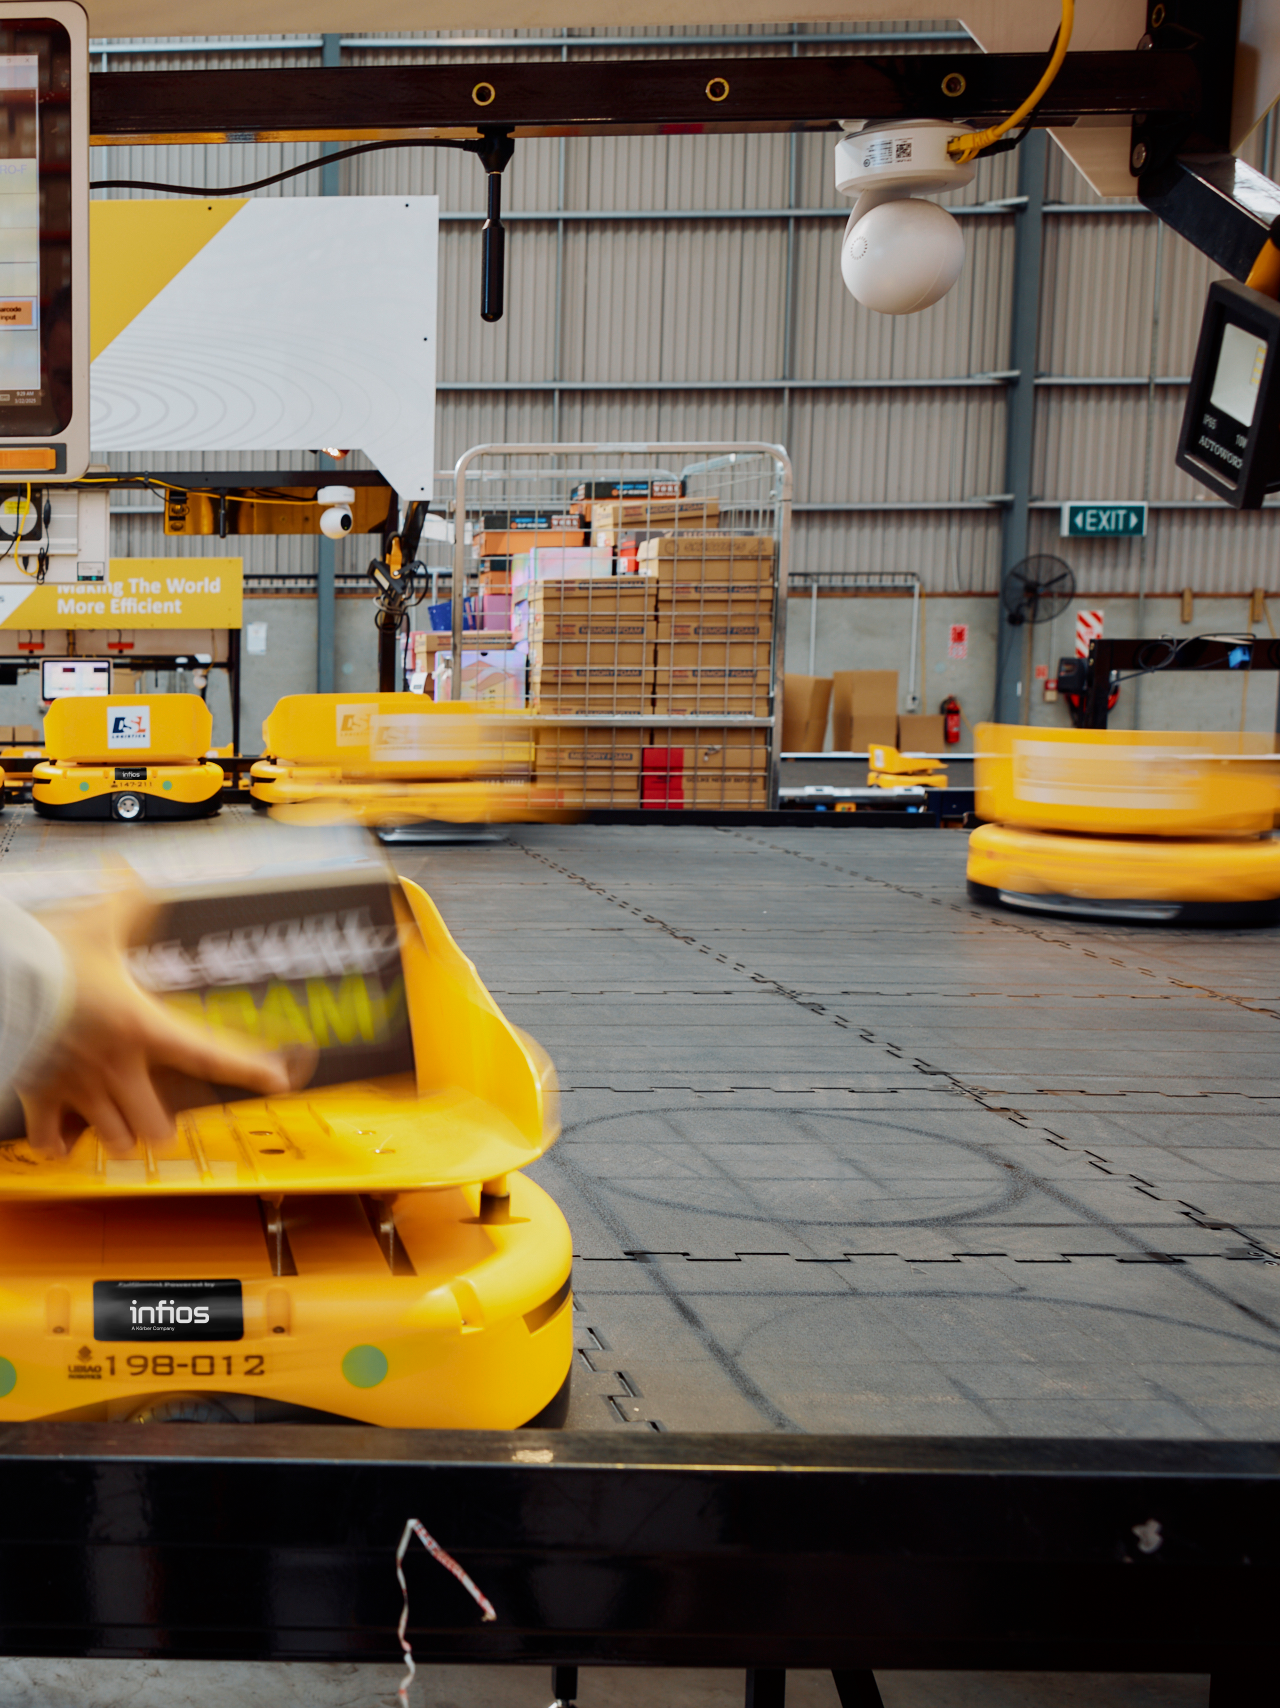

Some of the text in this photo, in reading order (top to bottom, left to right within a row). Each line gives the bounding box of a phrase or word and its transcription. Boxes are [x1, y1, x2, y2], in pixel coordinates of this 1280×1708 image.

[0, 313, 16, 321] input
[1086, 509, 1128, 532] EXIT
[57, 577, 221, 597] Making The World
[57, 597, 182, 615] More Efficient
[112, 715, 147, 734] DSL
[129, 1299, 210, 1324] infios
[68, 1365, 102, 1373] LIBIAO
[105, 1355, 266, 1376] 198-012
